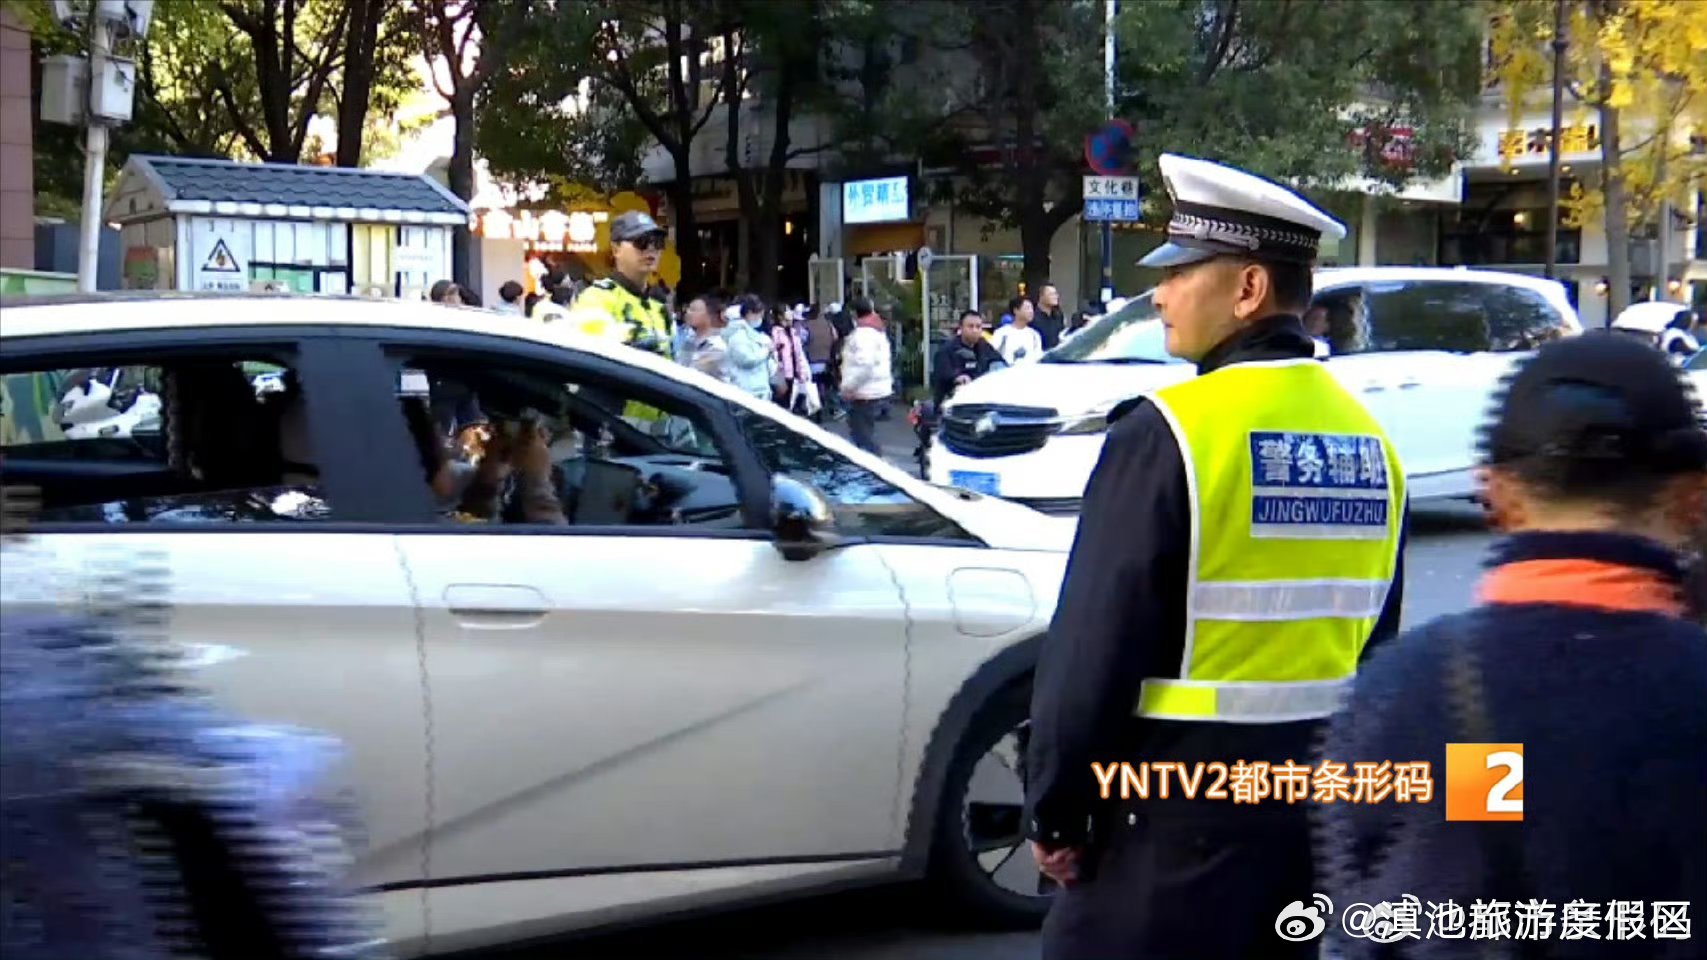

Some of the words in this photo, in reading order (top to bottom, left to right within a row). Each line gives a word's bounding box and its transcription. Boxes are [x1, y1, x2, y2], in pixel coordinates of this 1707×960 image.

[1088, 179, 1134, 195] 文化巷
[1259, 500, 1384, 523] JINGWUFUZHU
